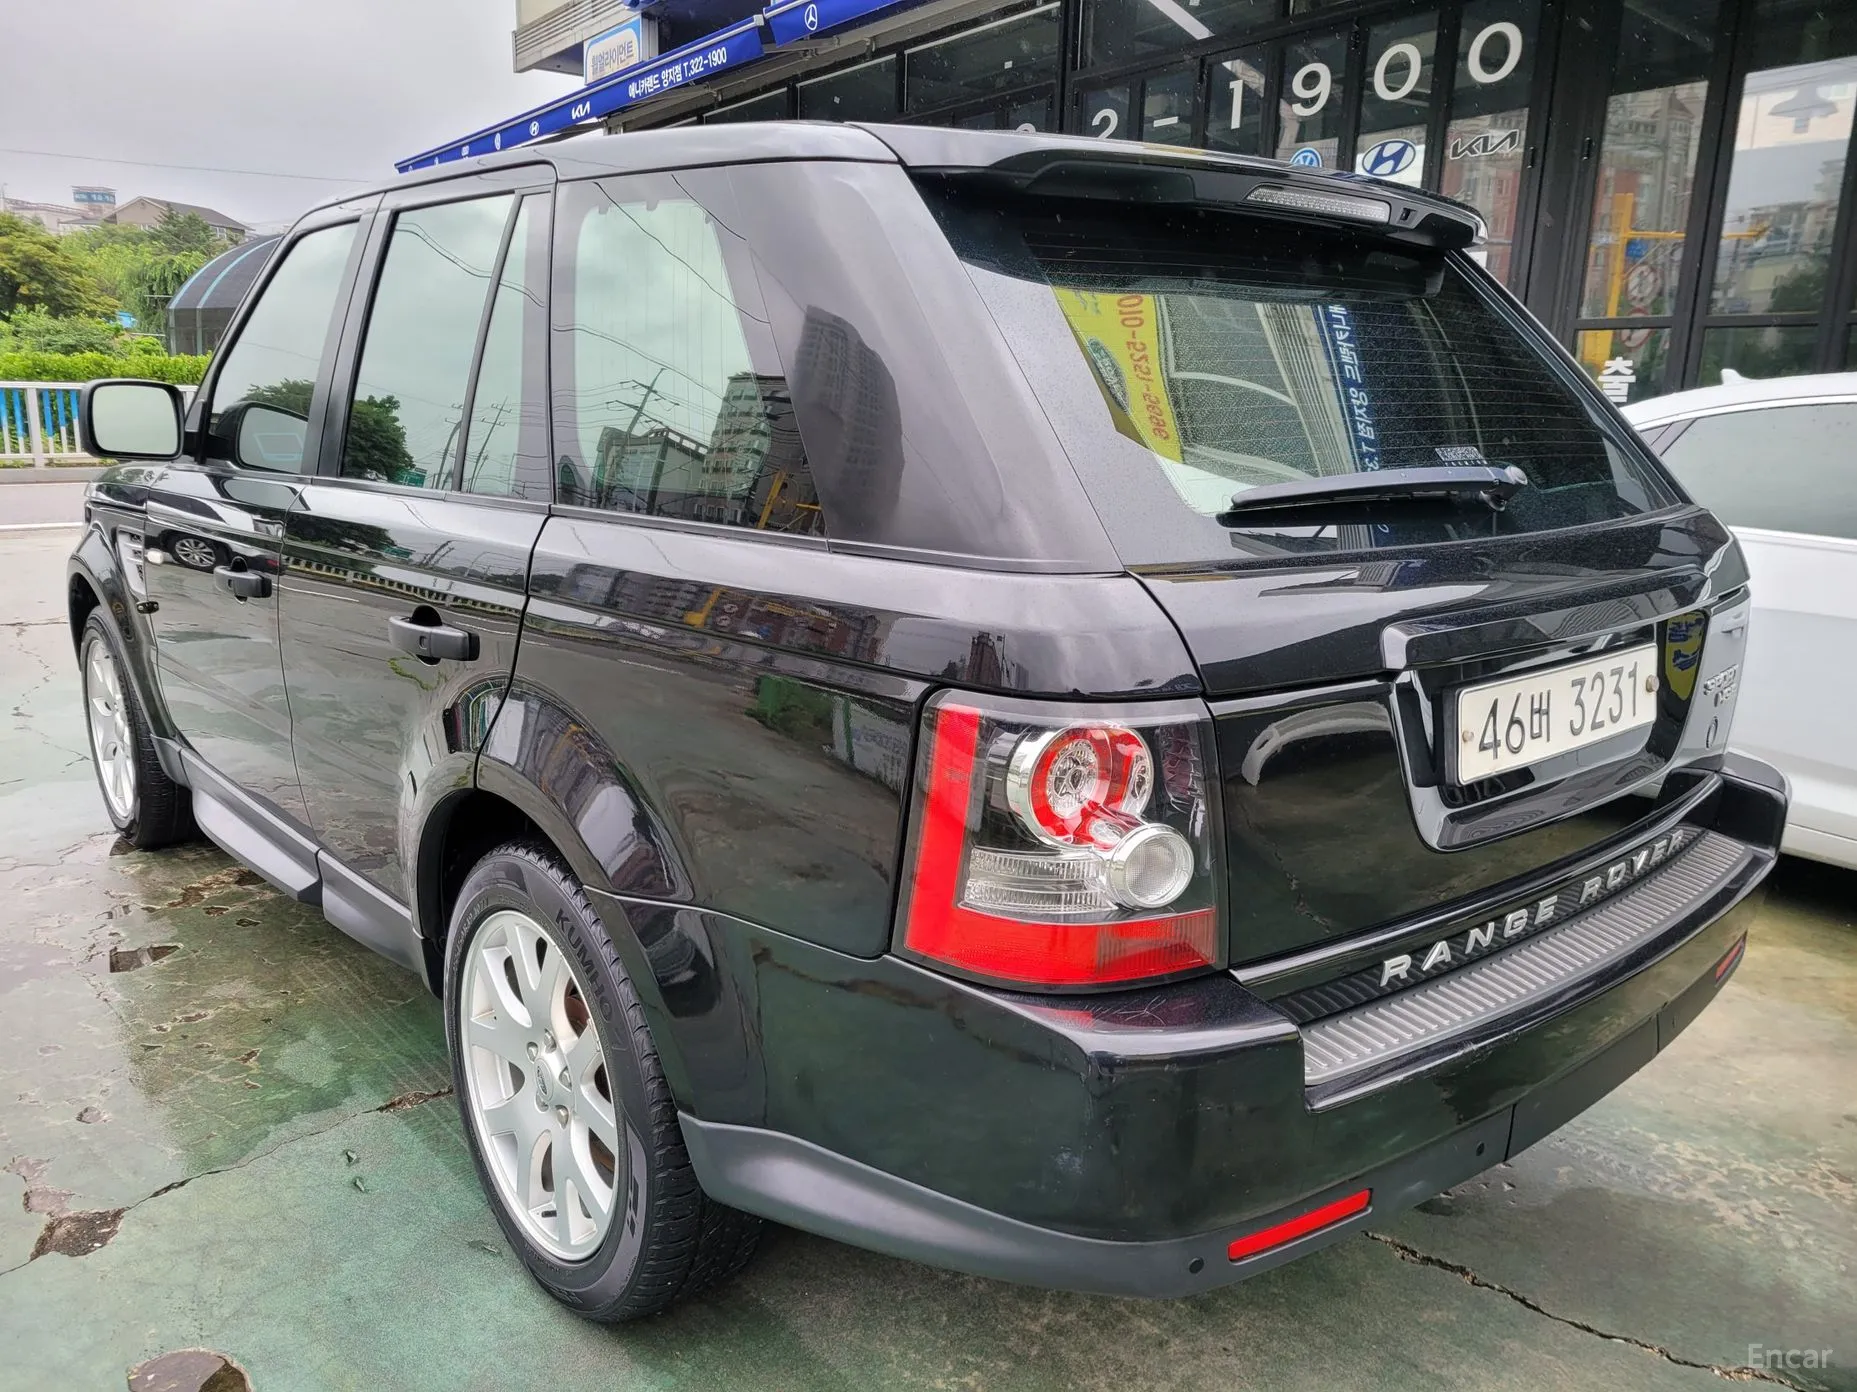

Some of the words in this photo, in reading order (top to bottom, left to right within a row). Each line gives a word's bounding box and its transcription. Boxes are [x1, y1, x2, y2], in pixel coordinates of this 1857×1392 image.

[628, 78, 661, 98] 애니카랜드
[661, 67, 683, 87] 양지점
[683, 47, 728, 77] T.322-1900
[1016, 22, 1523, 140] 2-1900
[1598, 356, 1636, 403] 출
[1479, 689, 1551, 759] 46버
[1570, 661, 1638, 736] 3231
[1380, 895, 1558, 987] RANGE
[1579, 829, 1685, 904] ROVER
[555, 908, 613, 1023] KUMHO
